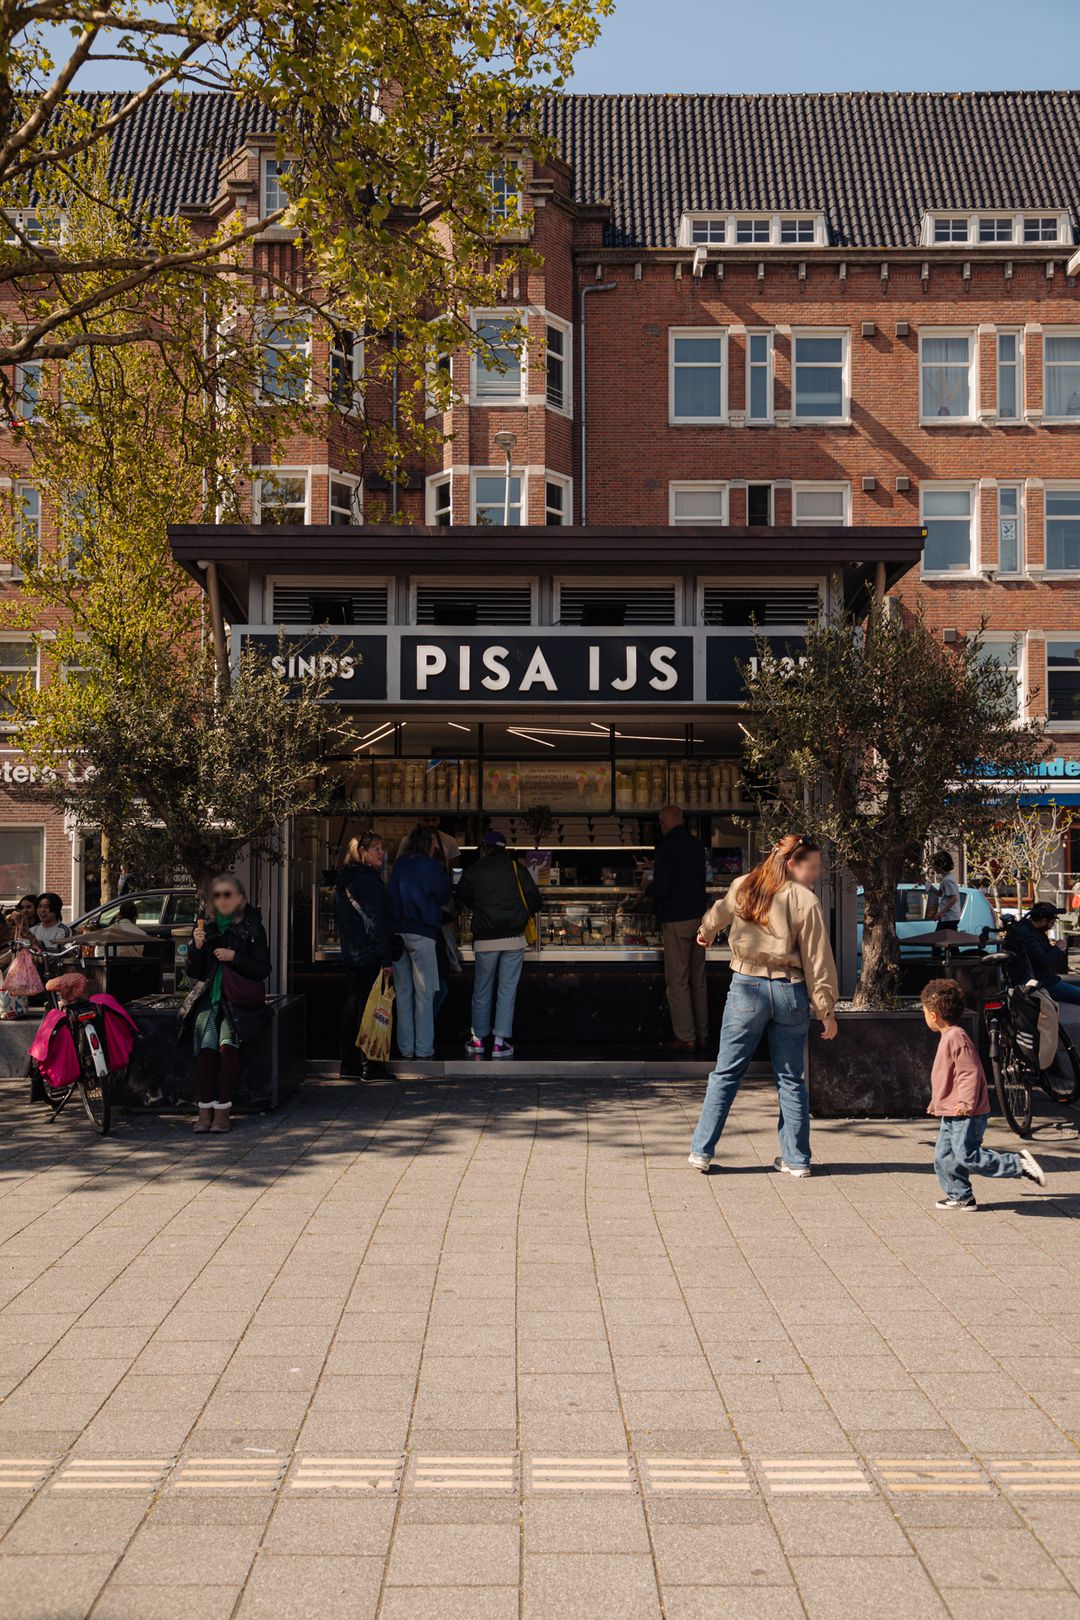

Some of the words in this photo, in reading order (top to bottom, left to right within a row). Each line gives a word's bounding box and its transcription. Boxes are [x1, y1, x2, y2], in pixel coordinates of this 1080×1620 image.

[271, 655, 355, 680] SINDS
[415, 645, 559, 692] PISA
[588, 645, 679, 692] IJS
[0, 761, 57, 783] ters
